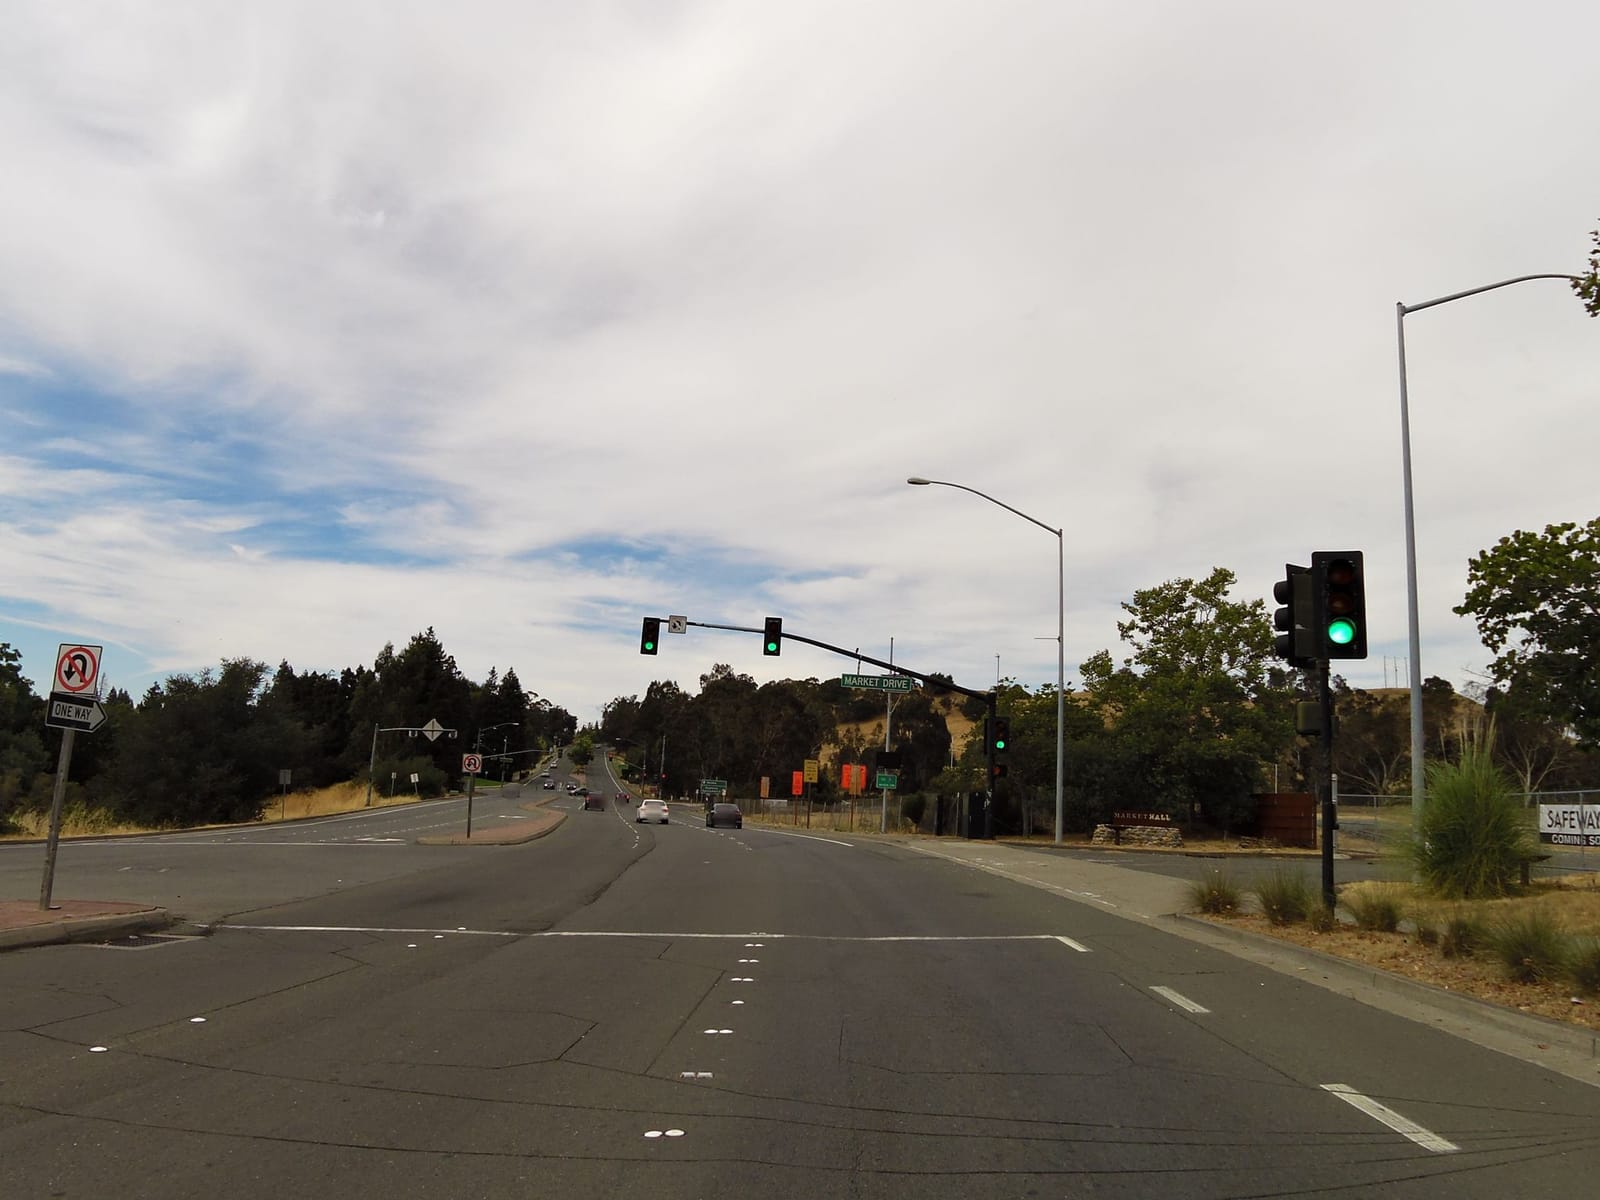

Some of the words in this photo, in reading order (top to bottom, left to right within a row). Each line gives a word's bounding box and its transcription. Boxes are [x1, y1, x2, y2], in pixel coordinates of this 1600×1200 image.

[844, 676, 880, 687] MARKET
[882, 679, 908, 689] DRIVE
[55, 703, 73, 718] ONE
[74, 706, 92, 720] WAY
[1547, 810, 1600, 829] SAFEWAY
[1551, 834, 1587, 846] COMING
